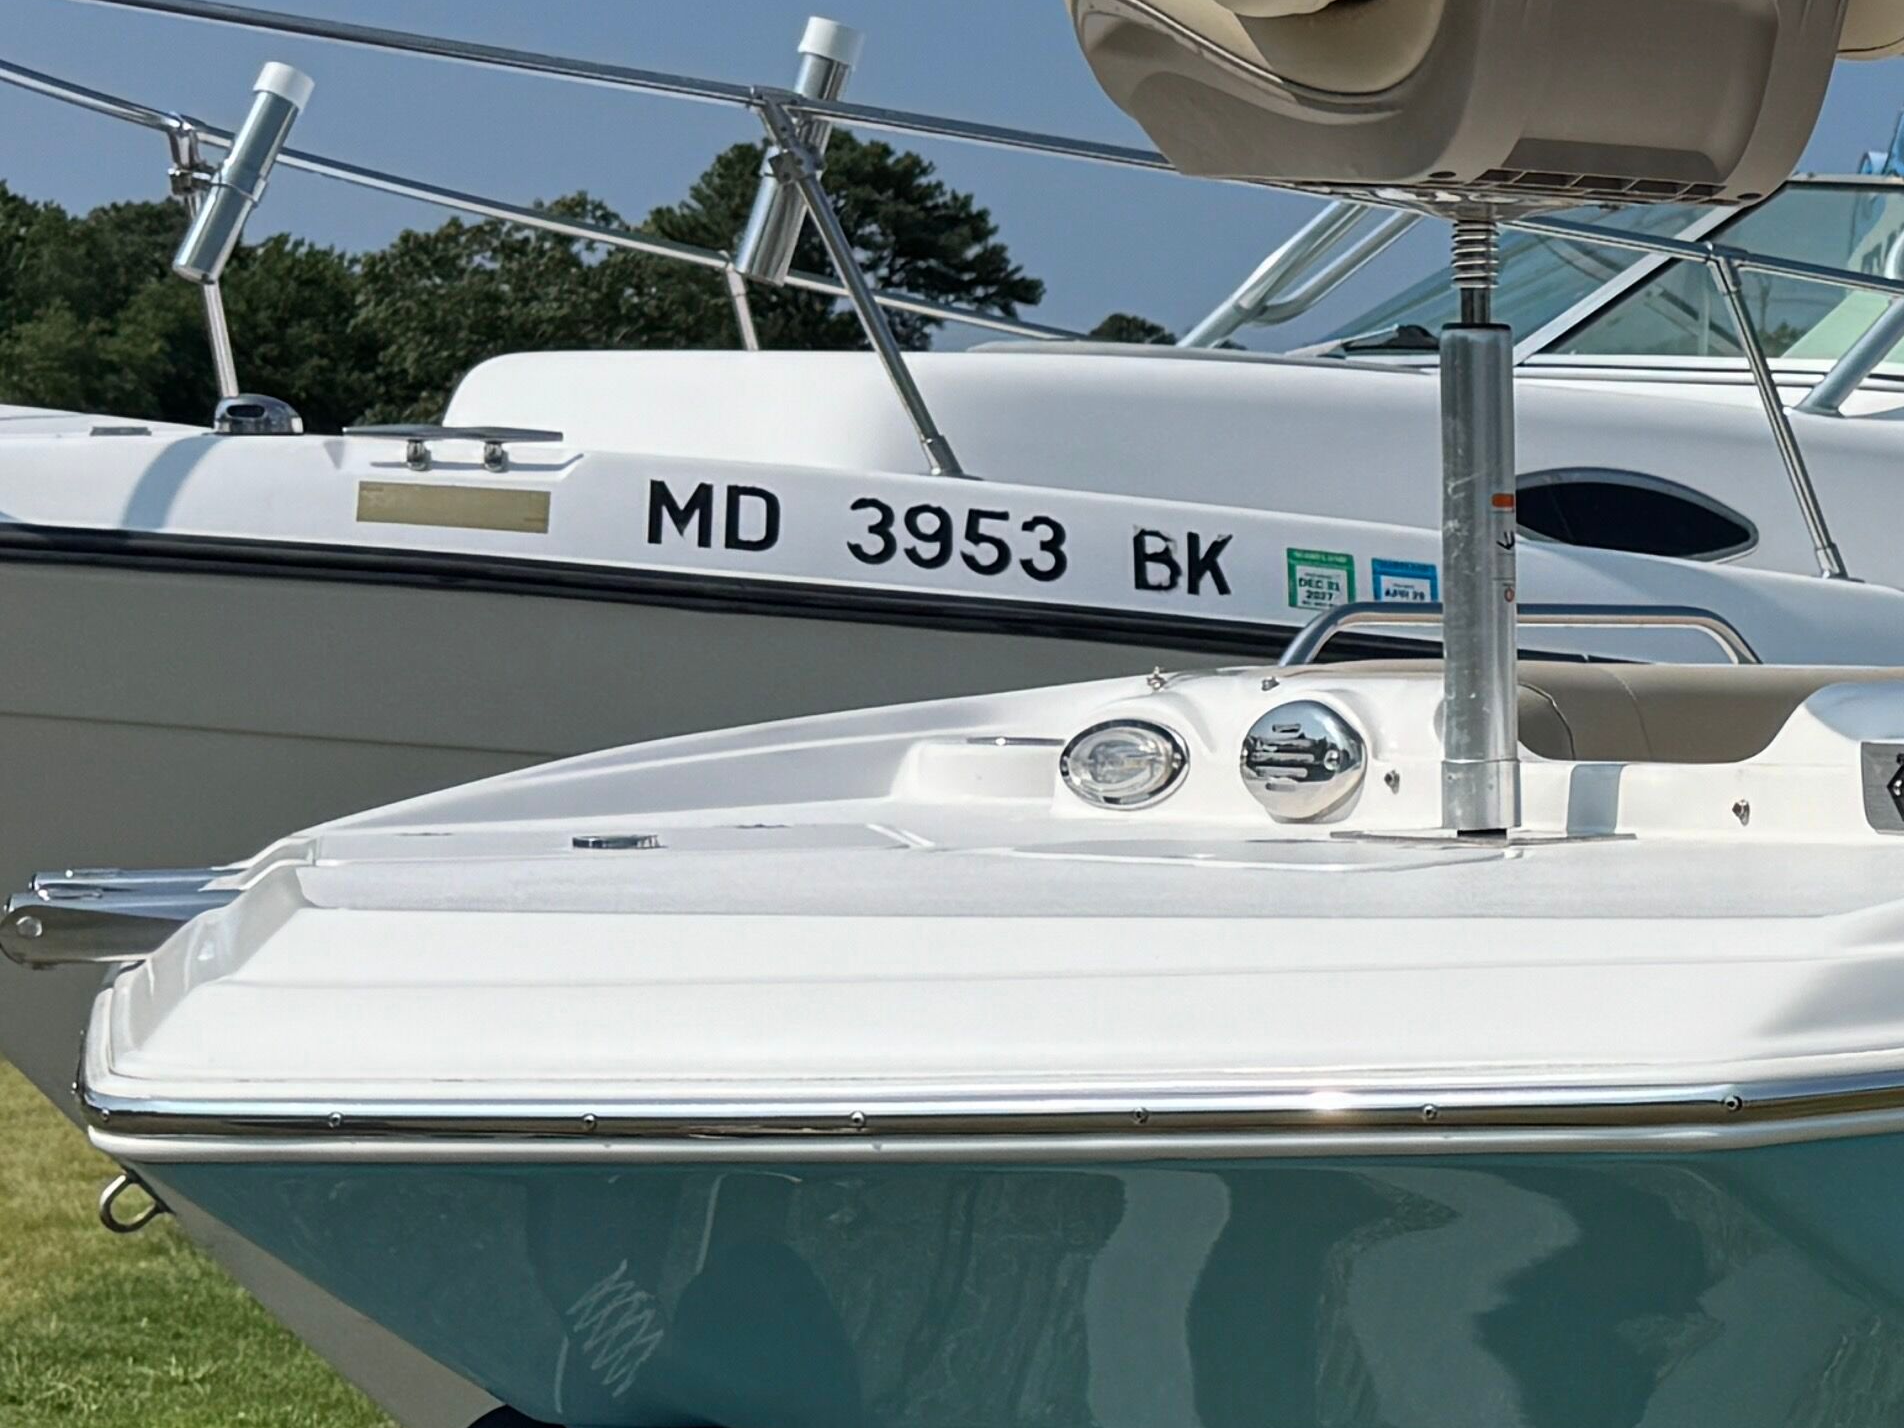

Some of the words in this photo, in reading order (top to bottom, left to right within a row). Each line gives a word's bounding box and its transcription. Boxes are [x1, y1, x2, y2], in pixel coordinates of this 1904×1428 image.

[646, 479, 781, 554] MD
[847, 496, 1068, 583] 3953
[1131, 524, 1235, 598] BK
